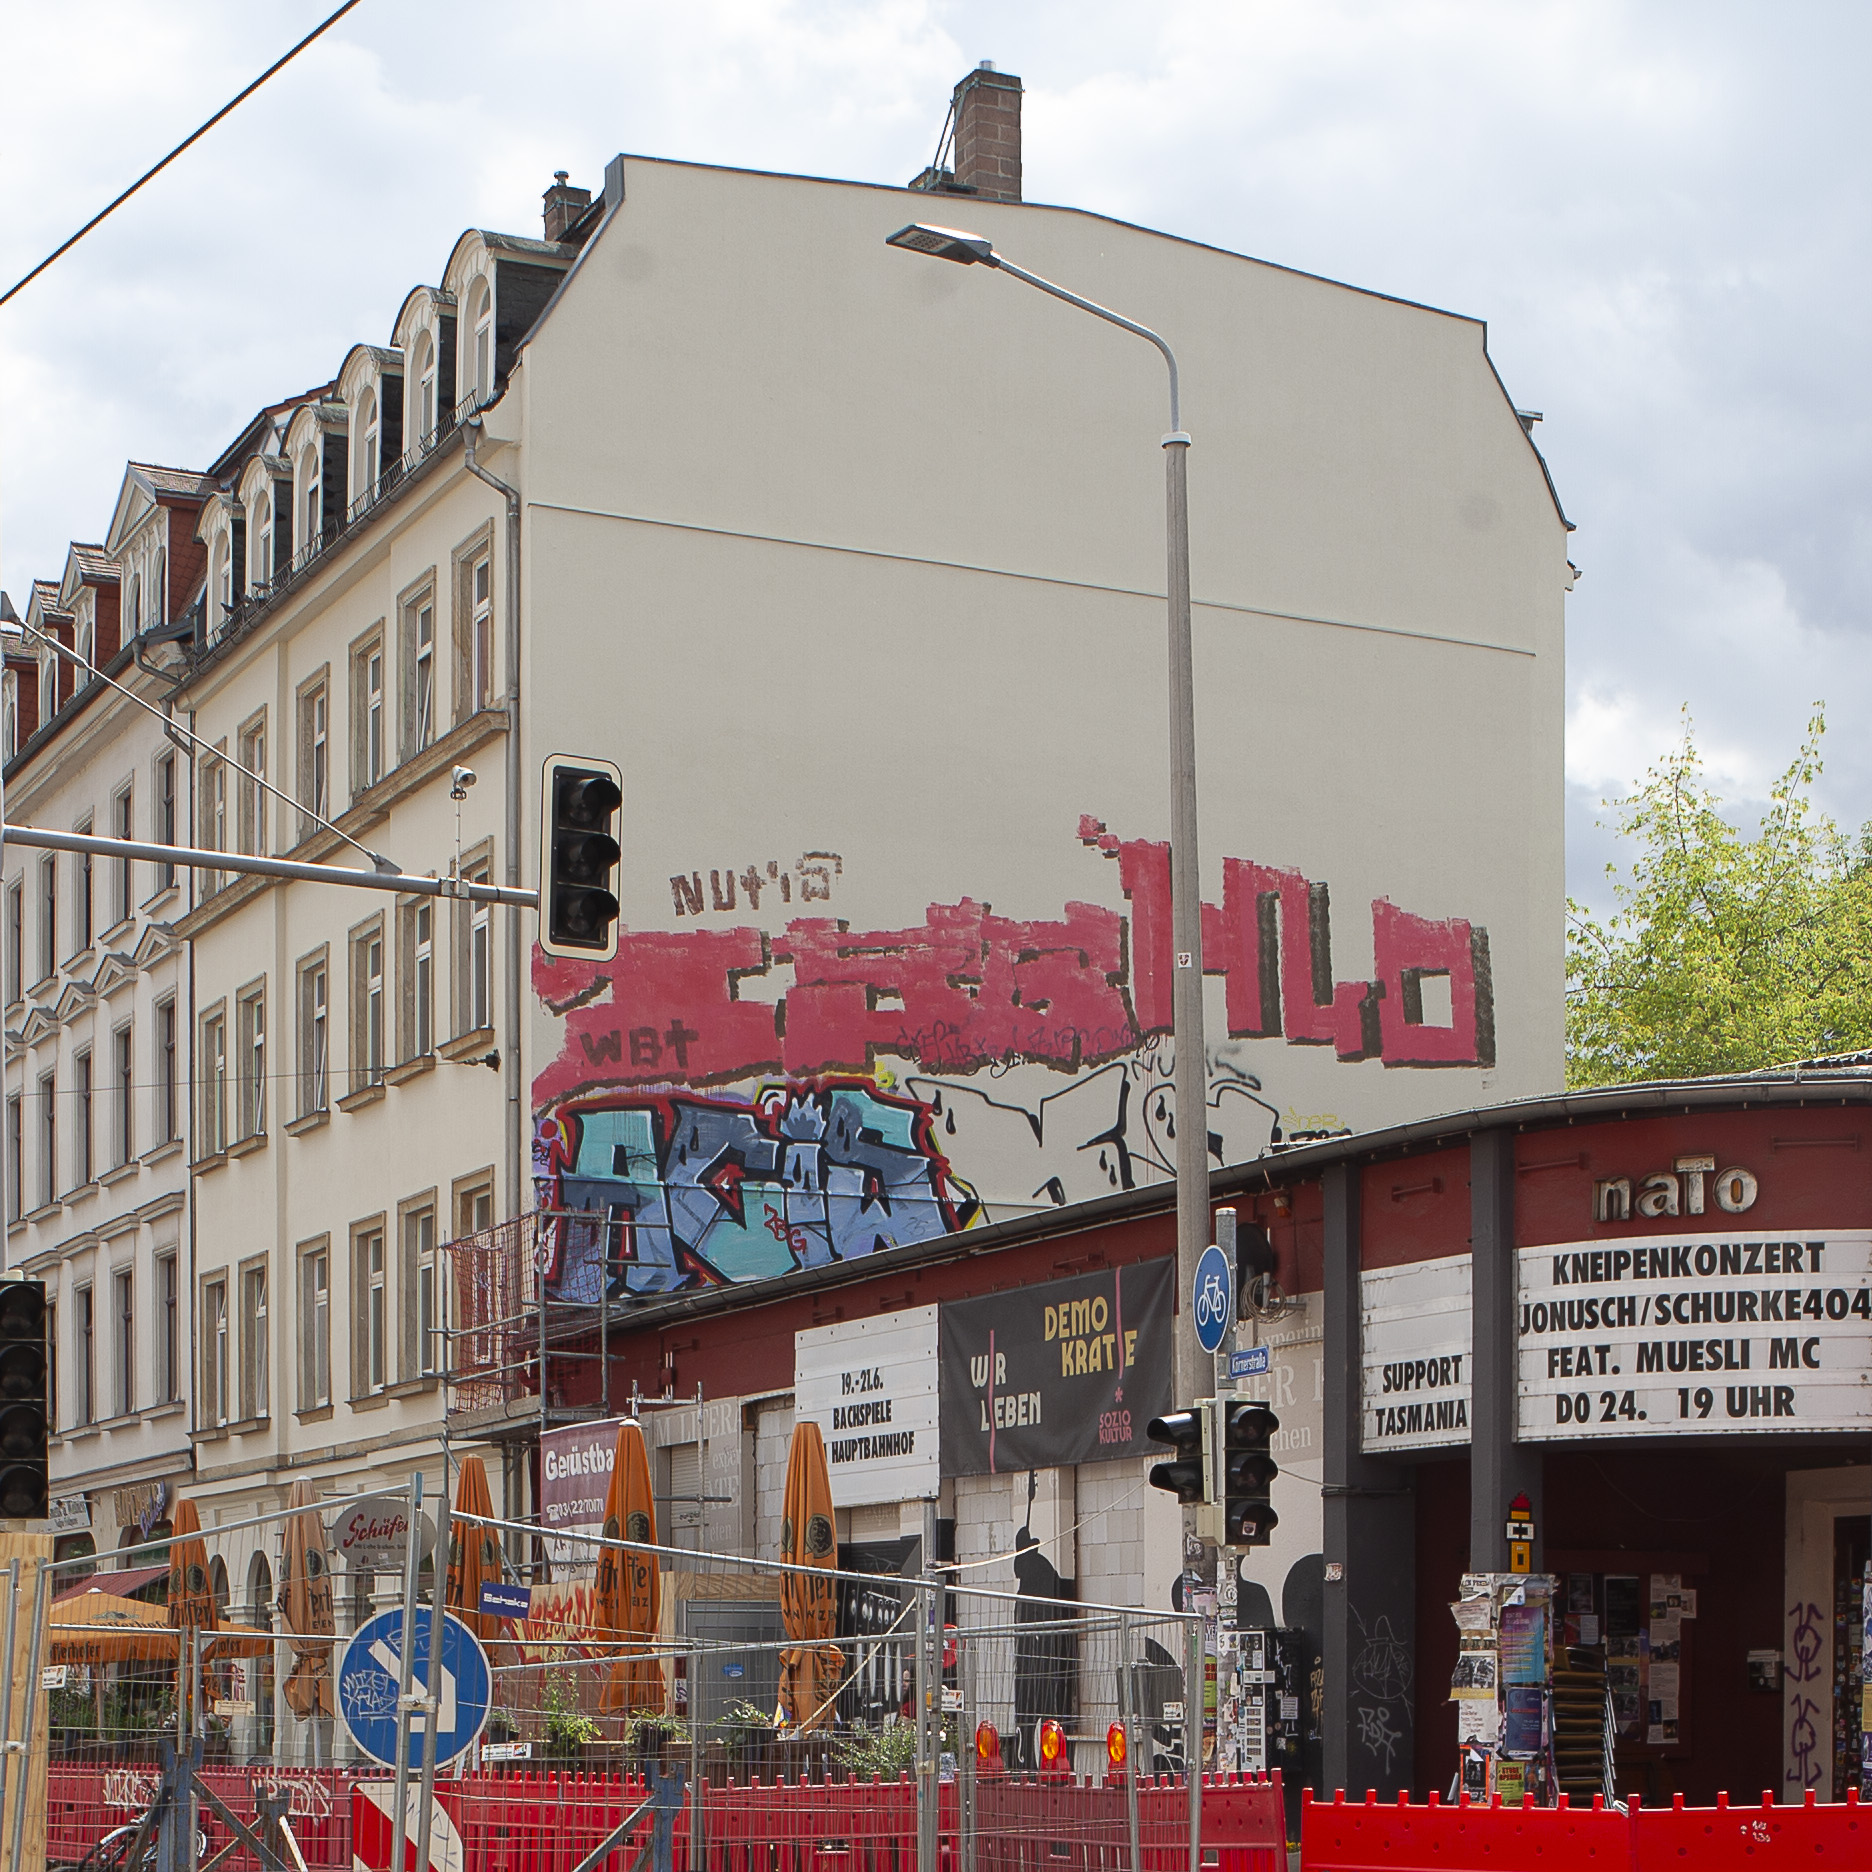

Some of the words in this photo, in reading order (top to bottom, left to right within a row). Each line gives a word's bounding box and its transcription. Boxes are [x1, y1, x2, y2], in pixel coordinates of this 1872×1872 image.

[1591, 1153, 1759, 1222] naTo
[1552, 1241, 1826, 1287] KNEIPENKONZERT
[1044, 1295, 1108, 1341] DEMO
[1520, 1288, 1872, 1335] JONUSCH/SCHURKE404
[1382, 1354, 1463, 1393] SUPPORT
[1547, 1344, 1621, 1379] FEAT.
[1636, 1338, 1750, 1374] MUESLI
[1768, 1336, 1821, 1370] MC
[833, 1399, 892, 1430] BACHSPIELE
[1099, 1409, 1131, 1428] SOZIO
[1375, 1399, 1468, 1437] TASMANIA
[1555, 1392, 1591, 1425] DO
[1599, 1390, 1647, 1423] 24.
[1677, 1386, 1714, 1420] 19
[1725, 1384, 1796, 1418] UHR
[831, 1430, 915, 1464] HAUPTBAHNHOF
[1099, 1426, 1132, 1444] KULTUR
